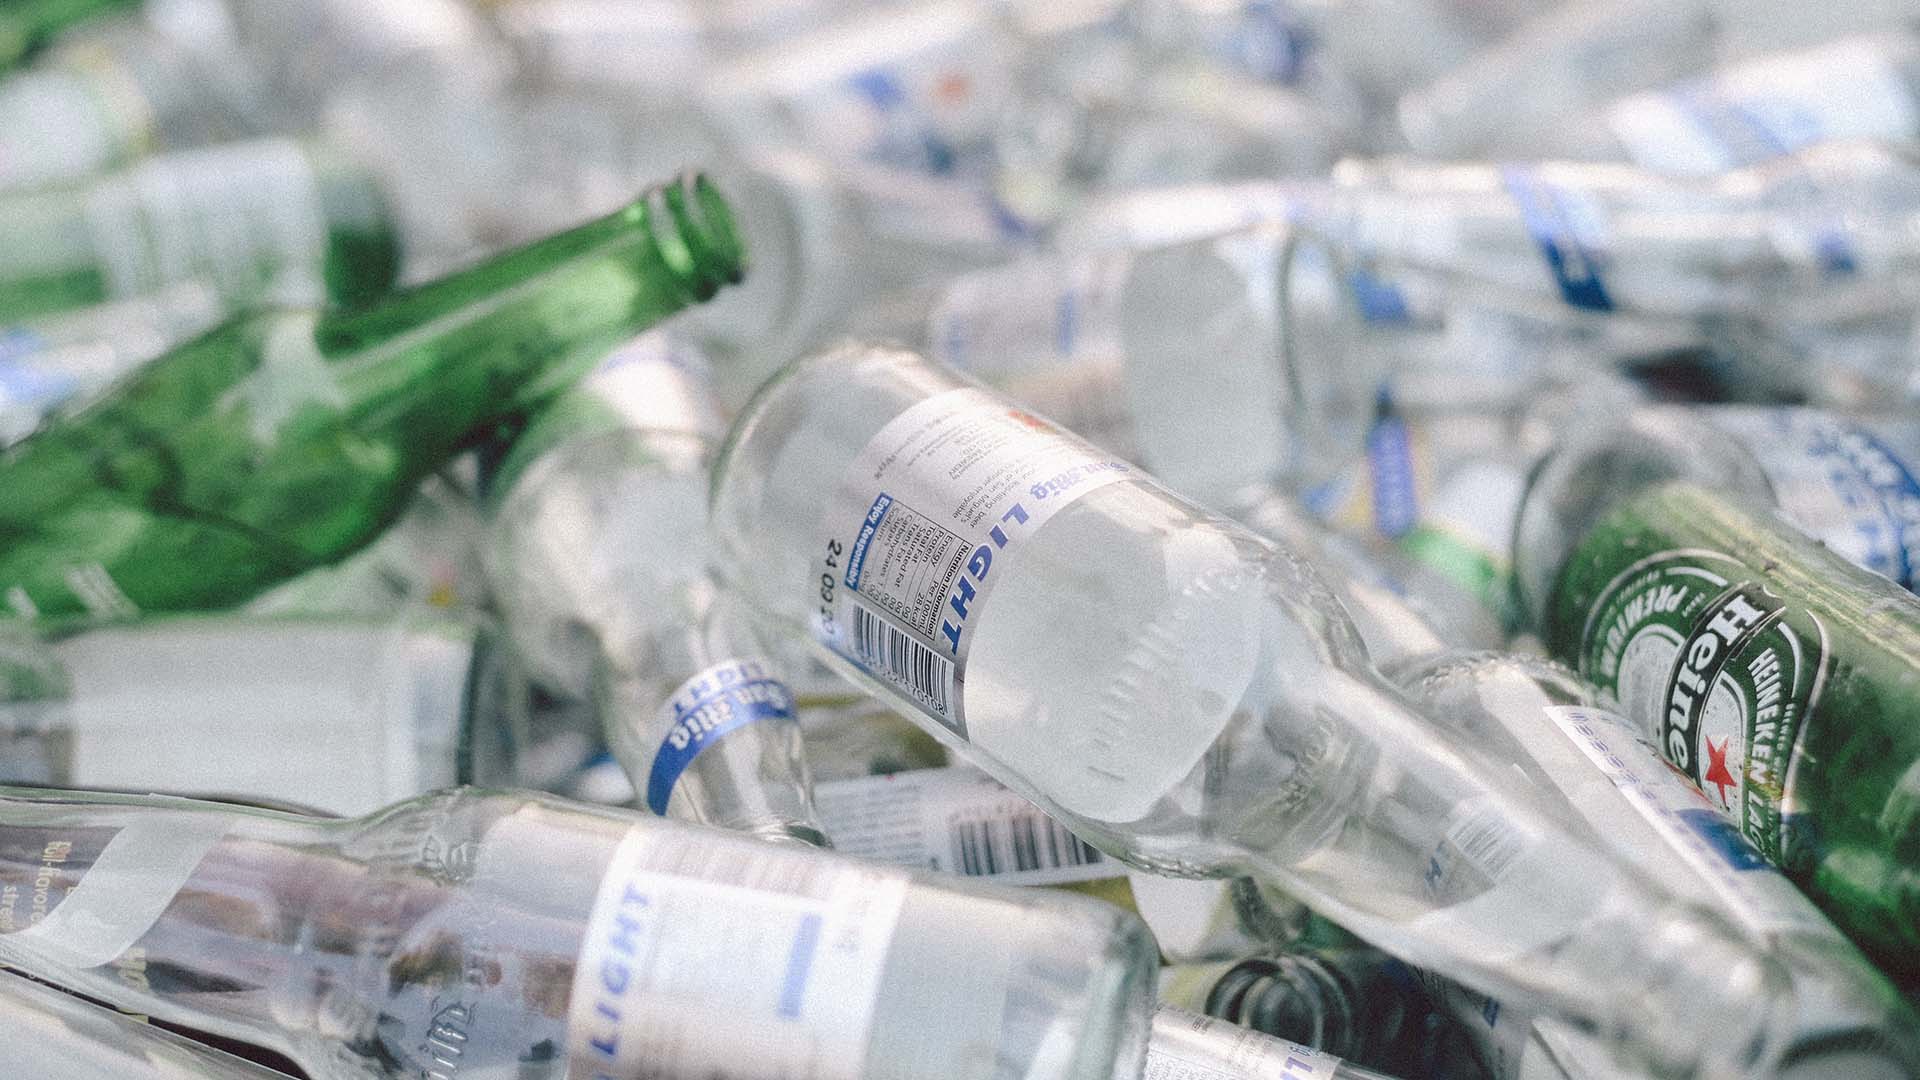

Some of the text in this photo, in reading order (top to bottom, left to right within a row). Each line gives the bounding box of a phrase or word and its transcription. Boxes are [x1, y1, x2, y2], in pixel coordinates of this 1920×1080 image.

[820, 538, 843, 572] 24
[847, 497, 890, 586] Enjoy Responsibly
[877, 507, 900, 540] Sodium
[880, 514, 913, 578] Carbohydrates
[884, 517, 904, 547] Sugars
[896, 546, 906, 563] Fat
[902, 523, 919, 547] Trans
[969, 510, 985, 529] beer
[818, 572, 836, 603] 09
[888, 528, 923, 610] Saturated Fat 0g
[894, 526, 936, 614] Total Fat 0g
[902, 530, 944, 619] Protein 0g
[911, 535, 953, 628] Energy 28 kcal
[928, 544, 969, 636] Nutrition Information
[929, 580, 939, 598] Per
[941, 502, 1029, 656] LIGHT
[1601, 584, 1690, 679] PREMIUM
[1747, 647, 1781, 786] HEINEKEN
[588, 881, 650, 1057] LIGHT
